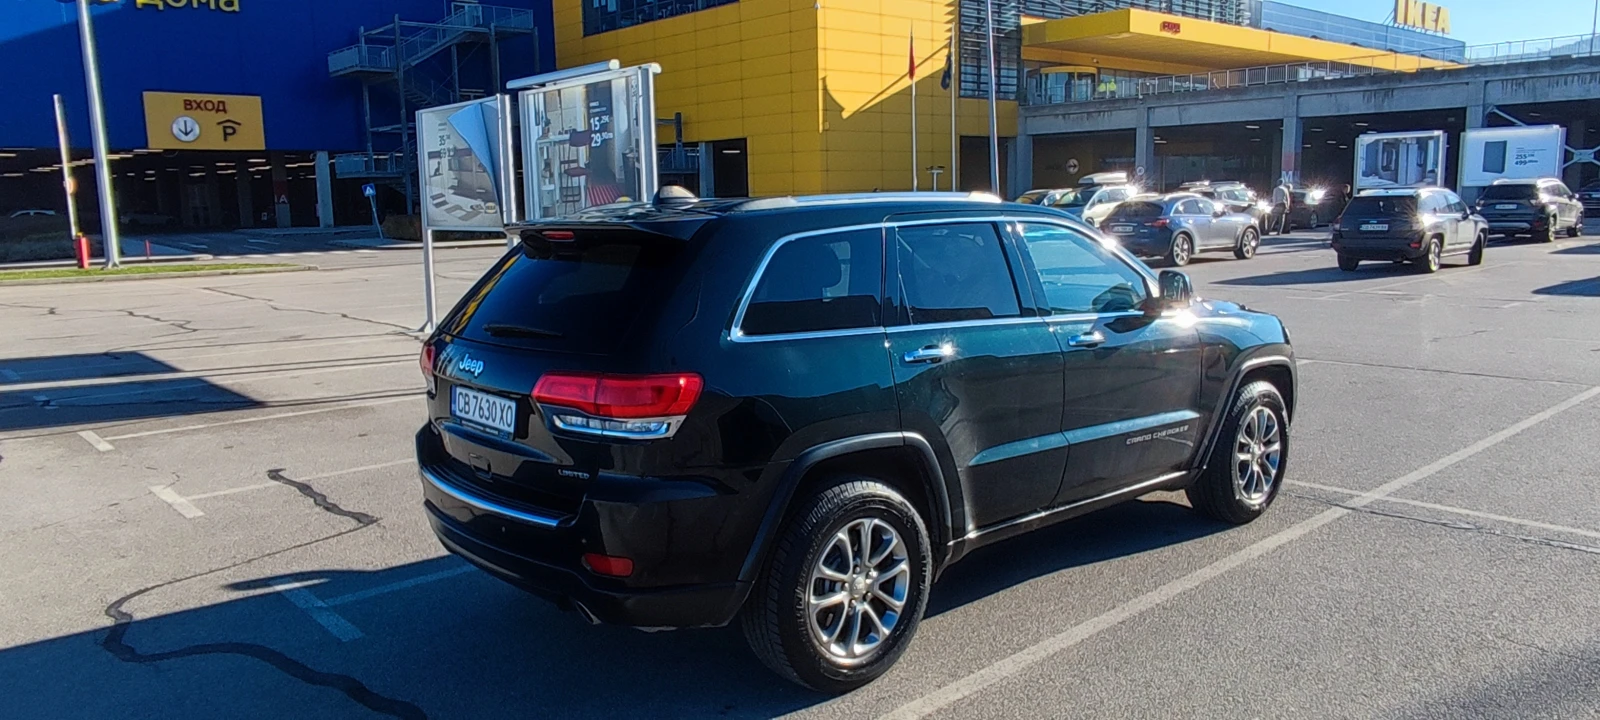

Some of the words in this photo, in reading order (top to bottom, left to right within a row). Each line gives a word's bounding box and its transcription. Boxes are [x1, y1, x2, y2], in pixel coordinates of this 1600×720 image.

[1395, 0, 1450, 34] IKEA
[183, 99, 227, 114] ВХОД
[222, 125, 237, 142] P
[459, 353, 484, 377] Jeep
[457, 391, 471, 415] CB
[472, 395, 498, 423] 7630
[499, 402, 514, 428] XO
